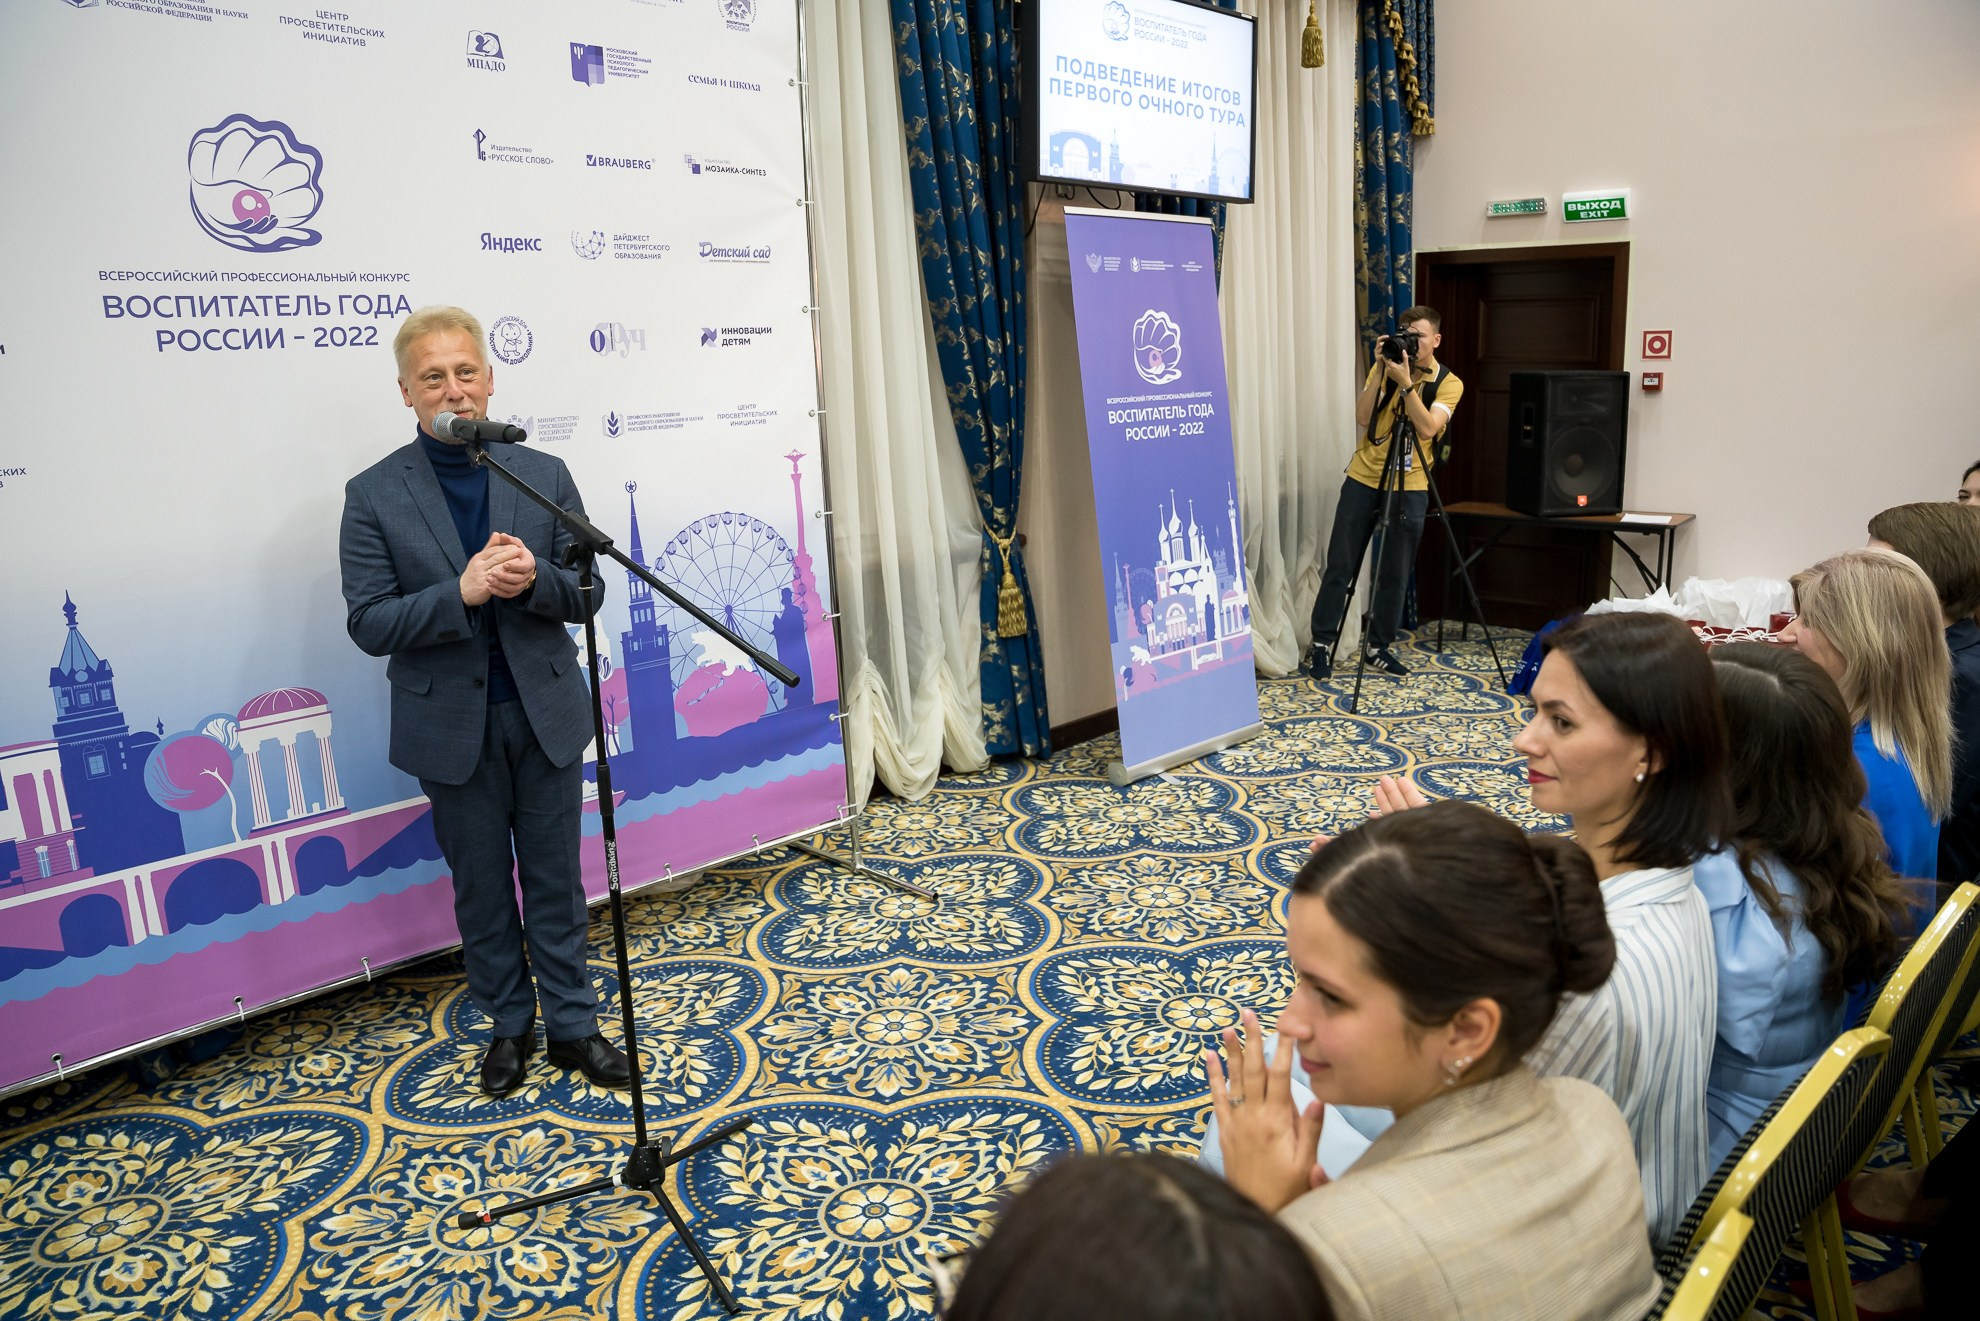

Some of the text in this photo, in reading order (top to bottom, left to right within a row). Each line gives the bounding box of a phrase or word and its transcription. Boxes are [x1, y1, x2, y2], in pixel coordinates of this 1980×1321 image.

[106, 0, 212, 22] РОССИЙСКОЙ ФЕДЕРАЦИИ
[222, 9, 249, 20] НАУКИ
[316, 9, 349, 21] ЦЕНТР
[279, 15, 385, 38] ПРОСВЕТИТЕЛЬСКИХ
[1134, 16, 1187, 37] ВОСПИТАТЕЛЬ
[1188, 30, 1207, 42] ГОДА
[303, 31, 366, 47] ИНИЦИАТИВ
[1134, 29, 1165, 43] РОССИИ
[1171, 37, 1188, 49] 2022
[606, 47, 638, 55] МОСКОВСКИЙ
[466, 57, 506, 72] МПАДО
[1056, 55, 1241, 106] ПОДВЕДЕНИЕ ИТОГОВ
[1049, 78, 1246, 128] ПЕРВОГО ОЧНОГО ТУРА
[490, 144, 532, 153] Издательство
[598, 156, 652, 170] BRAUBERG
[704, 165, 767, 177] МОЗАИКА-СИНТЕЗ
[1567, 200, 1621, 211] ВЫХОД
[1580, 210, 1610, 218] EXIT
[480, 232, 542, 253] Яндекс
[613, 233, 650, 242] ДАЙДЖЕСТ
[613, 243, 671, 251] ПЕТЕРБУРГСКОГО
[699, 241, 771, 259] Детский сад
[614, 252, 662, 260] ОБРАЗОВАНИЯ
[98, 270, 411, 282] ВСЕРОССИЙСКИЙ ПРОФЕССИОНАЛЬНЫЙ КОНКУРС
[102, 294, 413, 319] ВОСПИТАТЕЛЬ ГОДА
[721, 326, 772, 336] инновации
[156, 327, 285, 352] РОССИИ
[313, 325, 379, 348] 2022
[721, 337, 751, 347] детям
[717, 410, 778, 420] ПРОСВЕТИТЕЛЬСКИХ
[1108, 403, 1215, 424] ВОСПИТАТЕЛЬ ГОДА
[537, 416, 579, 424] МИНИСТЕРСТВО
[730, 419, 767, 427] ИНИЦИАТИВ
[538, 428, 573, 436] РОССИЙСКОЙ
[1125, 424, 1170, 441] РОССИИ
[1179, 421, 1205, 436] 2022
